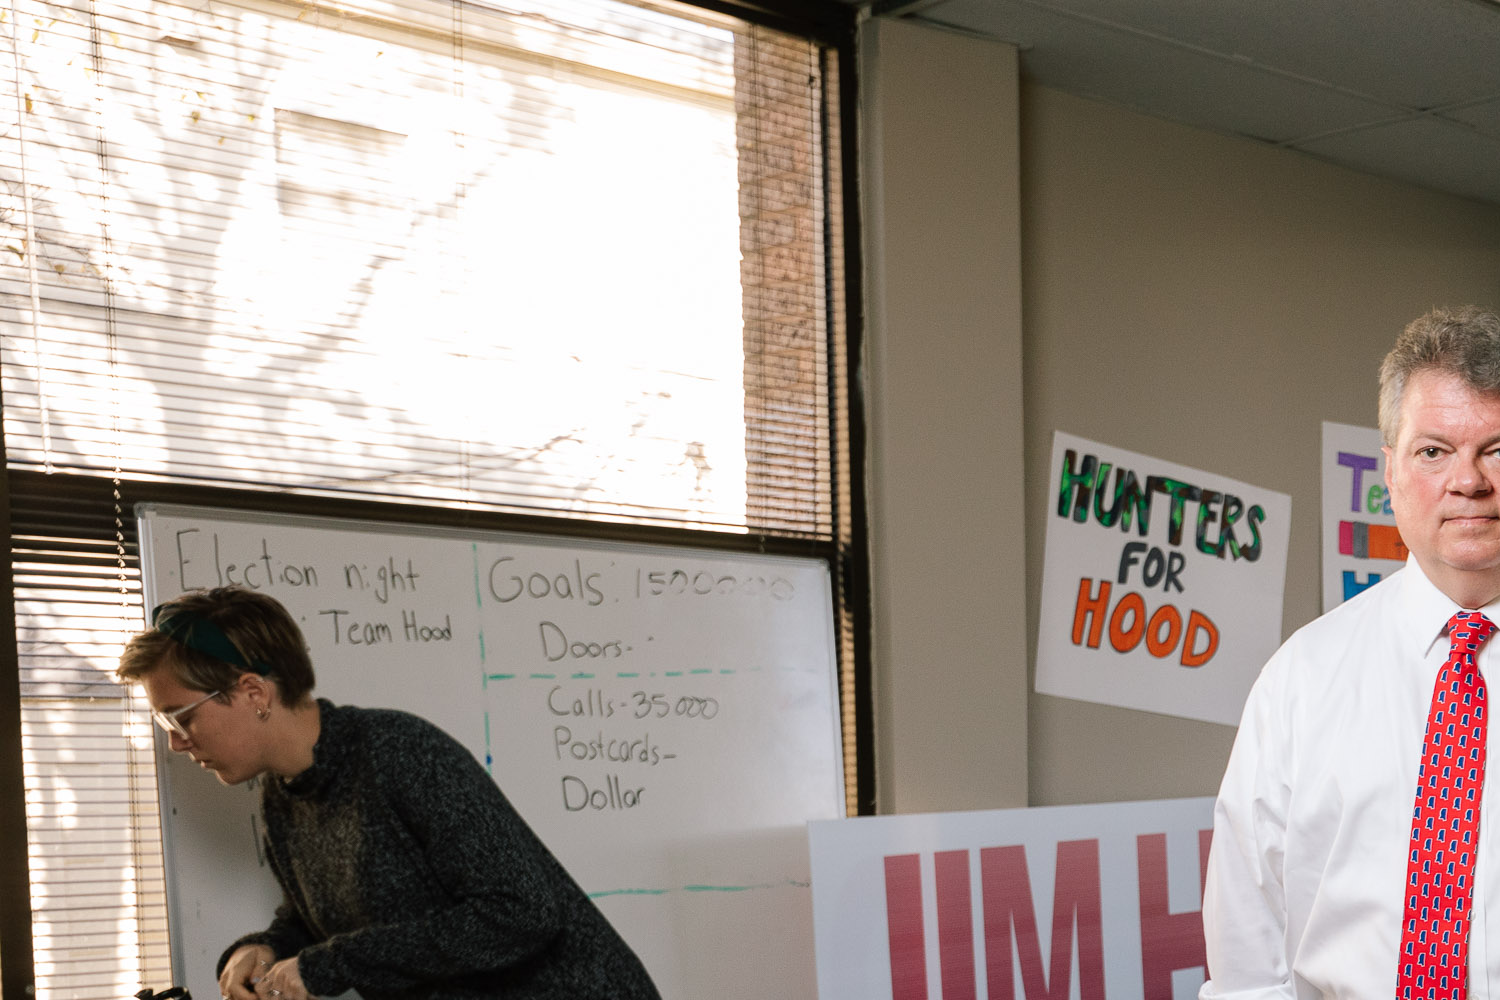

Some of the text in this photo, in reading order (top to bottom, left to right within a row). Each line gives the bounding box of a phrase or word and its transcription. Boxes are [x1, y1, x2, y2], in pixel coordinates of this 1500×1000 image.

[1056, 449, 1267, 562] HUNTERS
[176, 527, 420, 604] Election night
[1118, 541, 1185, 594] FOR
[319, 609, 454, 645] Team Hood
[1072, 577, 1220, 668] HOOD
[562, 774, 646, 812] Dollar
